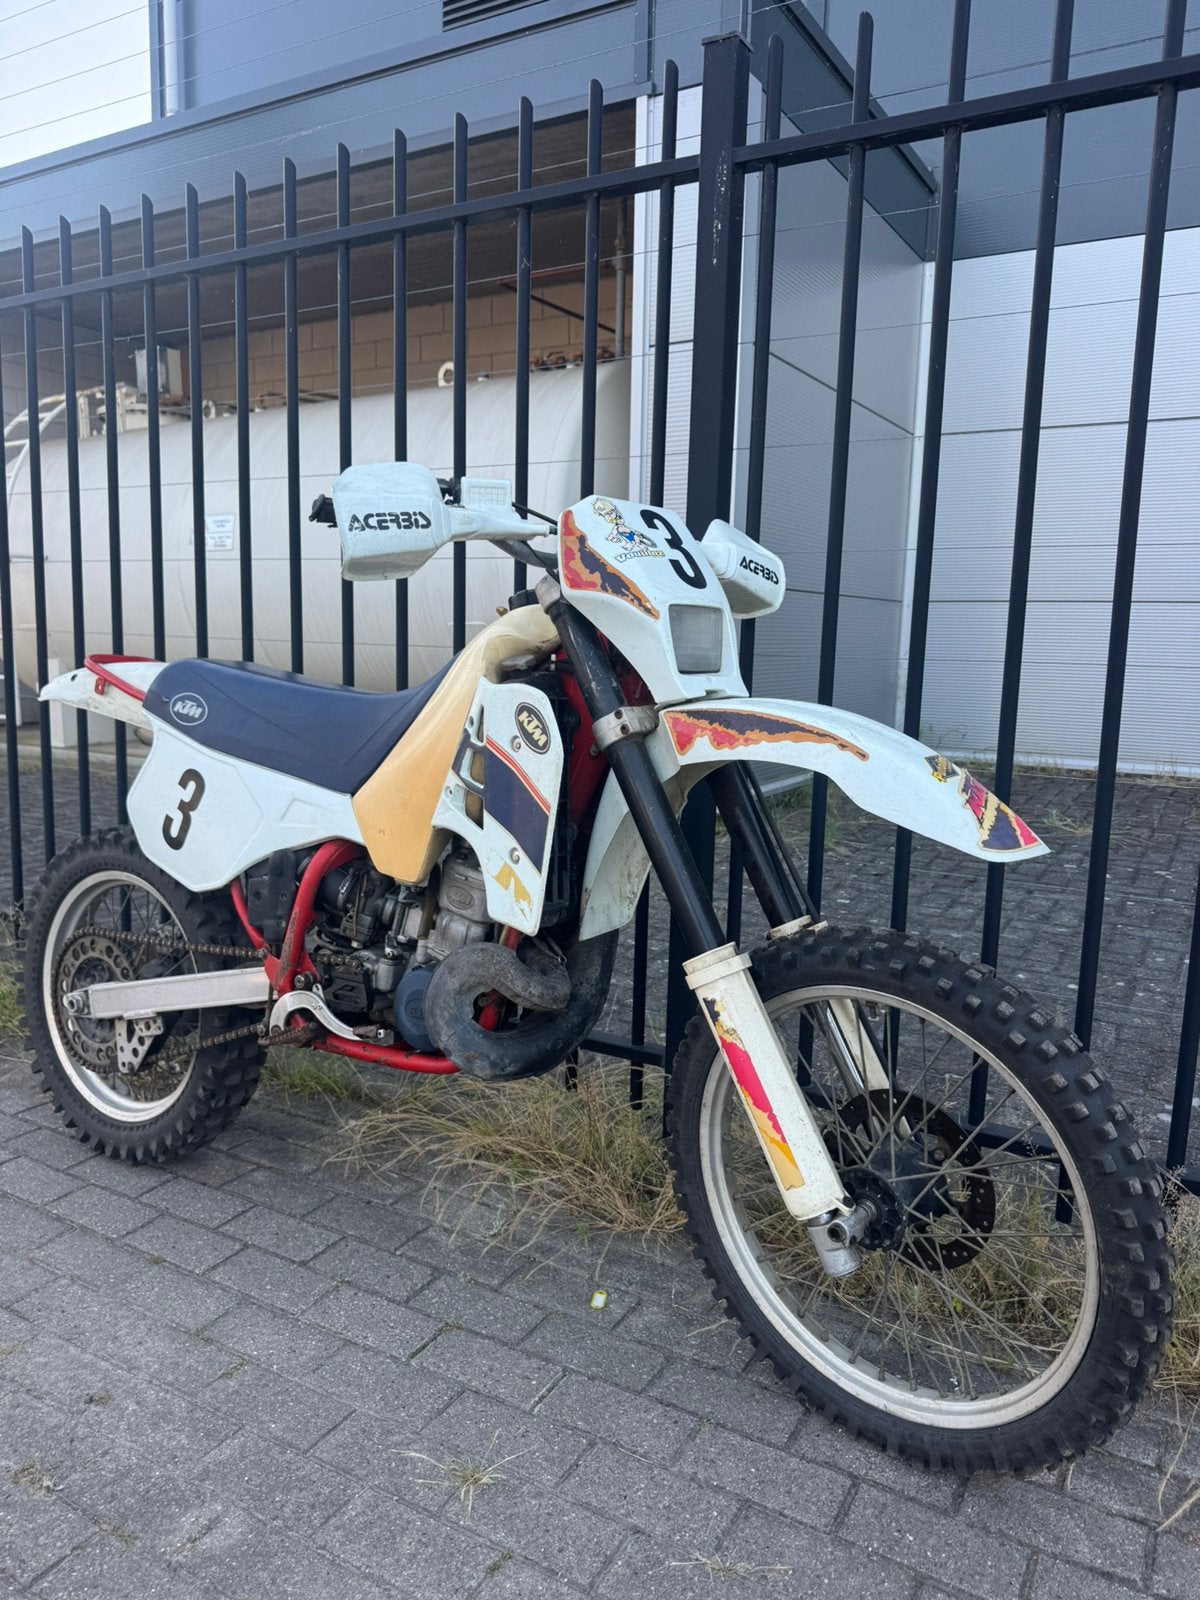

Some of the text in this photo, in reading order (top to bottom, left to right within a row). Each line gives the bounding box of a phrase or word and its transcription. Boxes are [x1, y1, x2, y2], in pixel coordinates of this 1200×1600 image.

[640, 509, 707, 589] 3
[173, 700, 203, 719] KTM
[518, 710, 548, 747] KTM
[162, 768, 206, 851] 3
